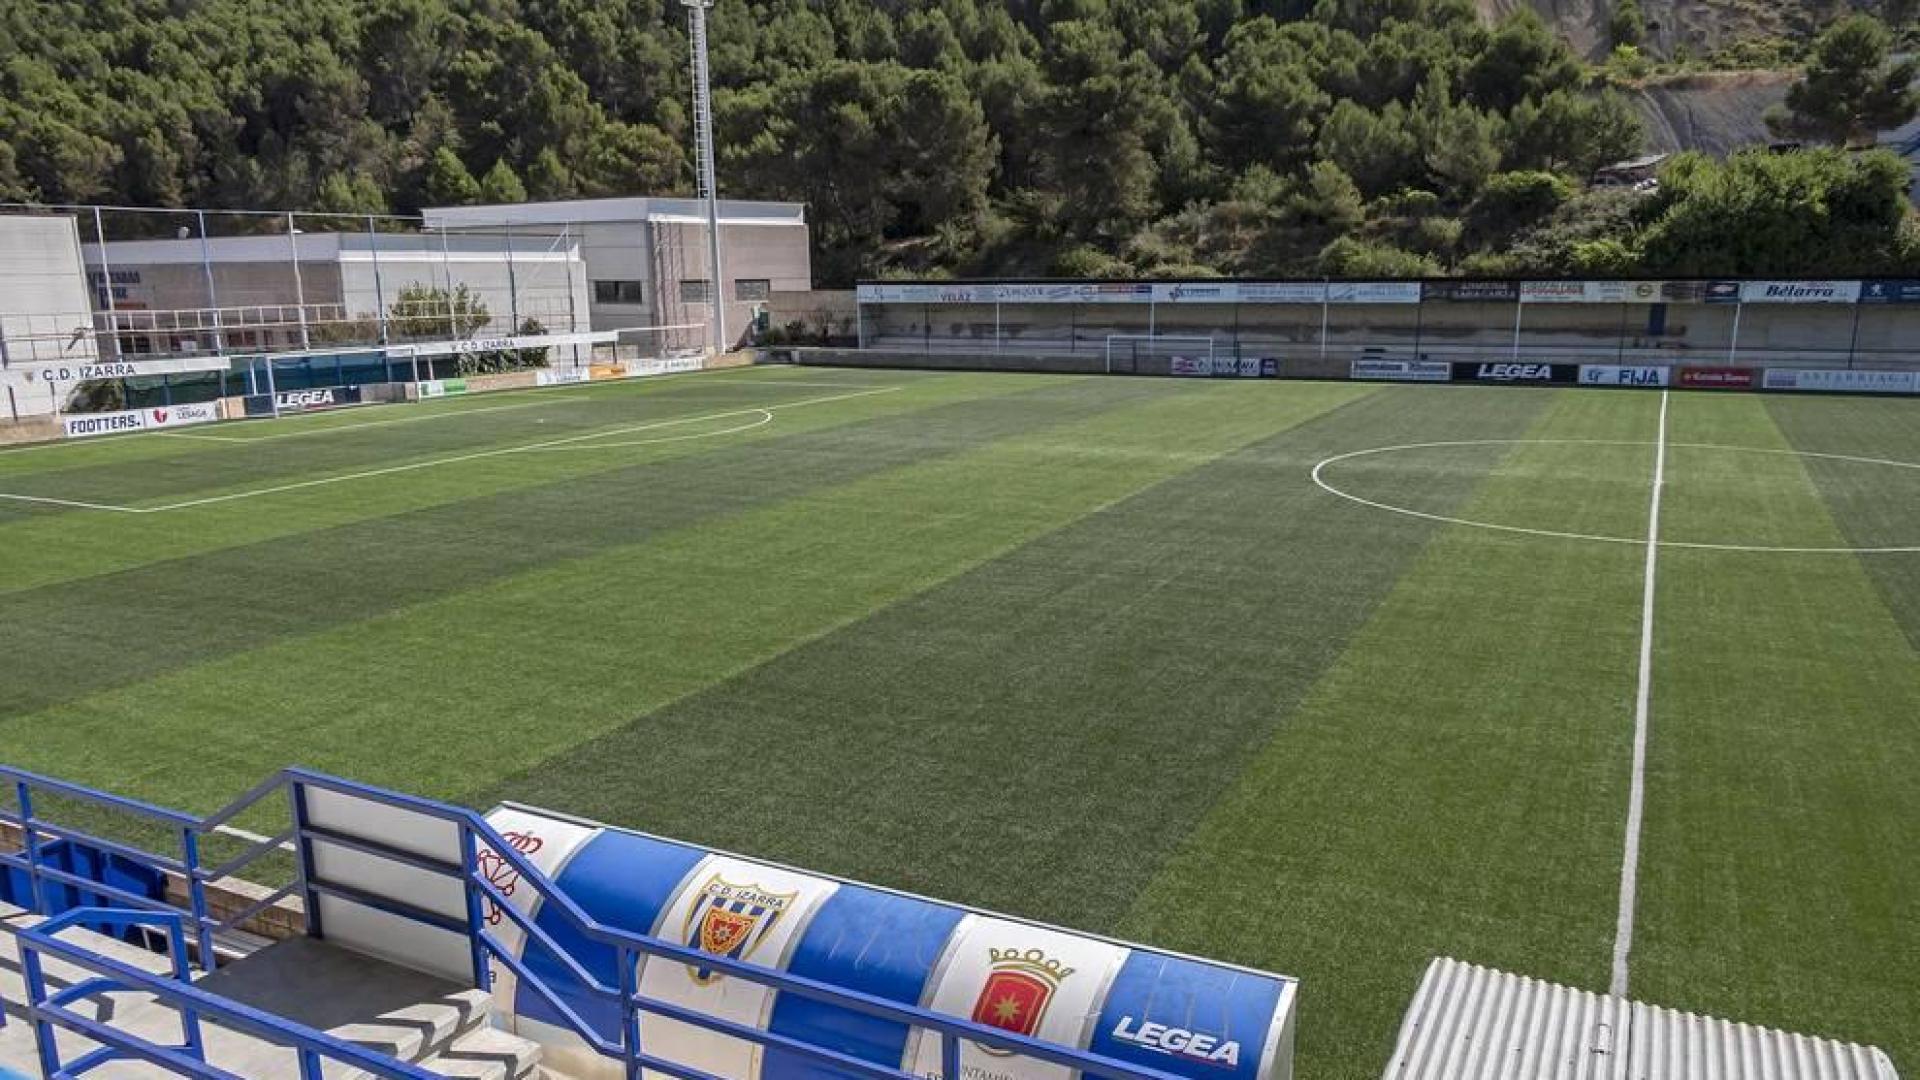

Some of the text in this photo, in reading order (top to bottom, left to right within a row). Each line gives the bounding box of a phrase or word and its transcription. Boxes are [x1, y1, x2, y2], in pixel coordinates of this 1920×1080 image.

[79, 363, 137, 379] IZARRA
[1477, 363, 1552, 379] LEGEA
[1618, 369, 1660, 385] FIJA
[276, 388, 335, 409] LEGEA
[736, 889, 784, 909] IZARRA
[1112, 1015, 1241, 1066] LEGEA
